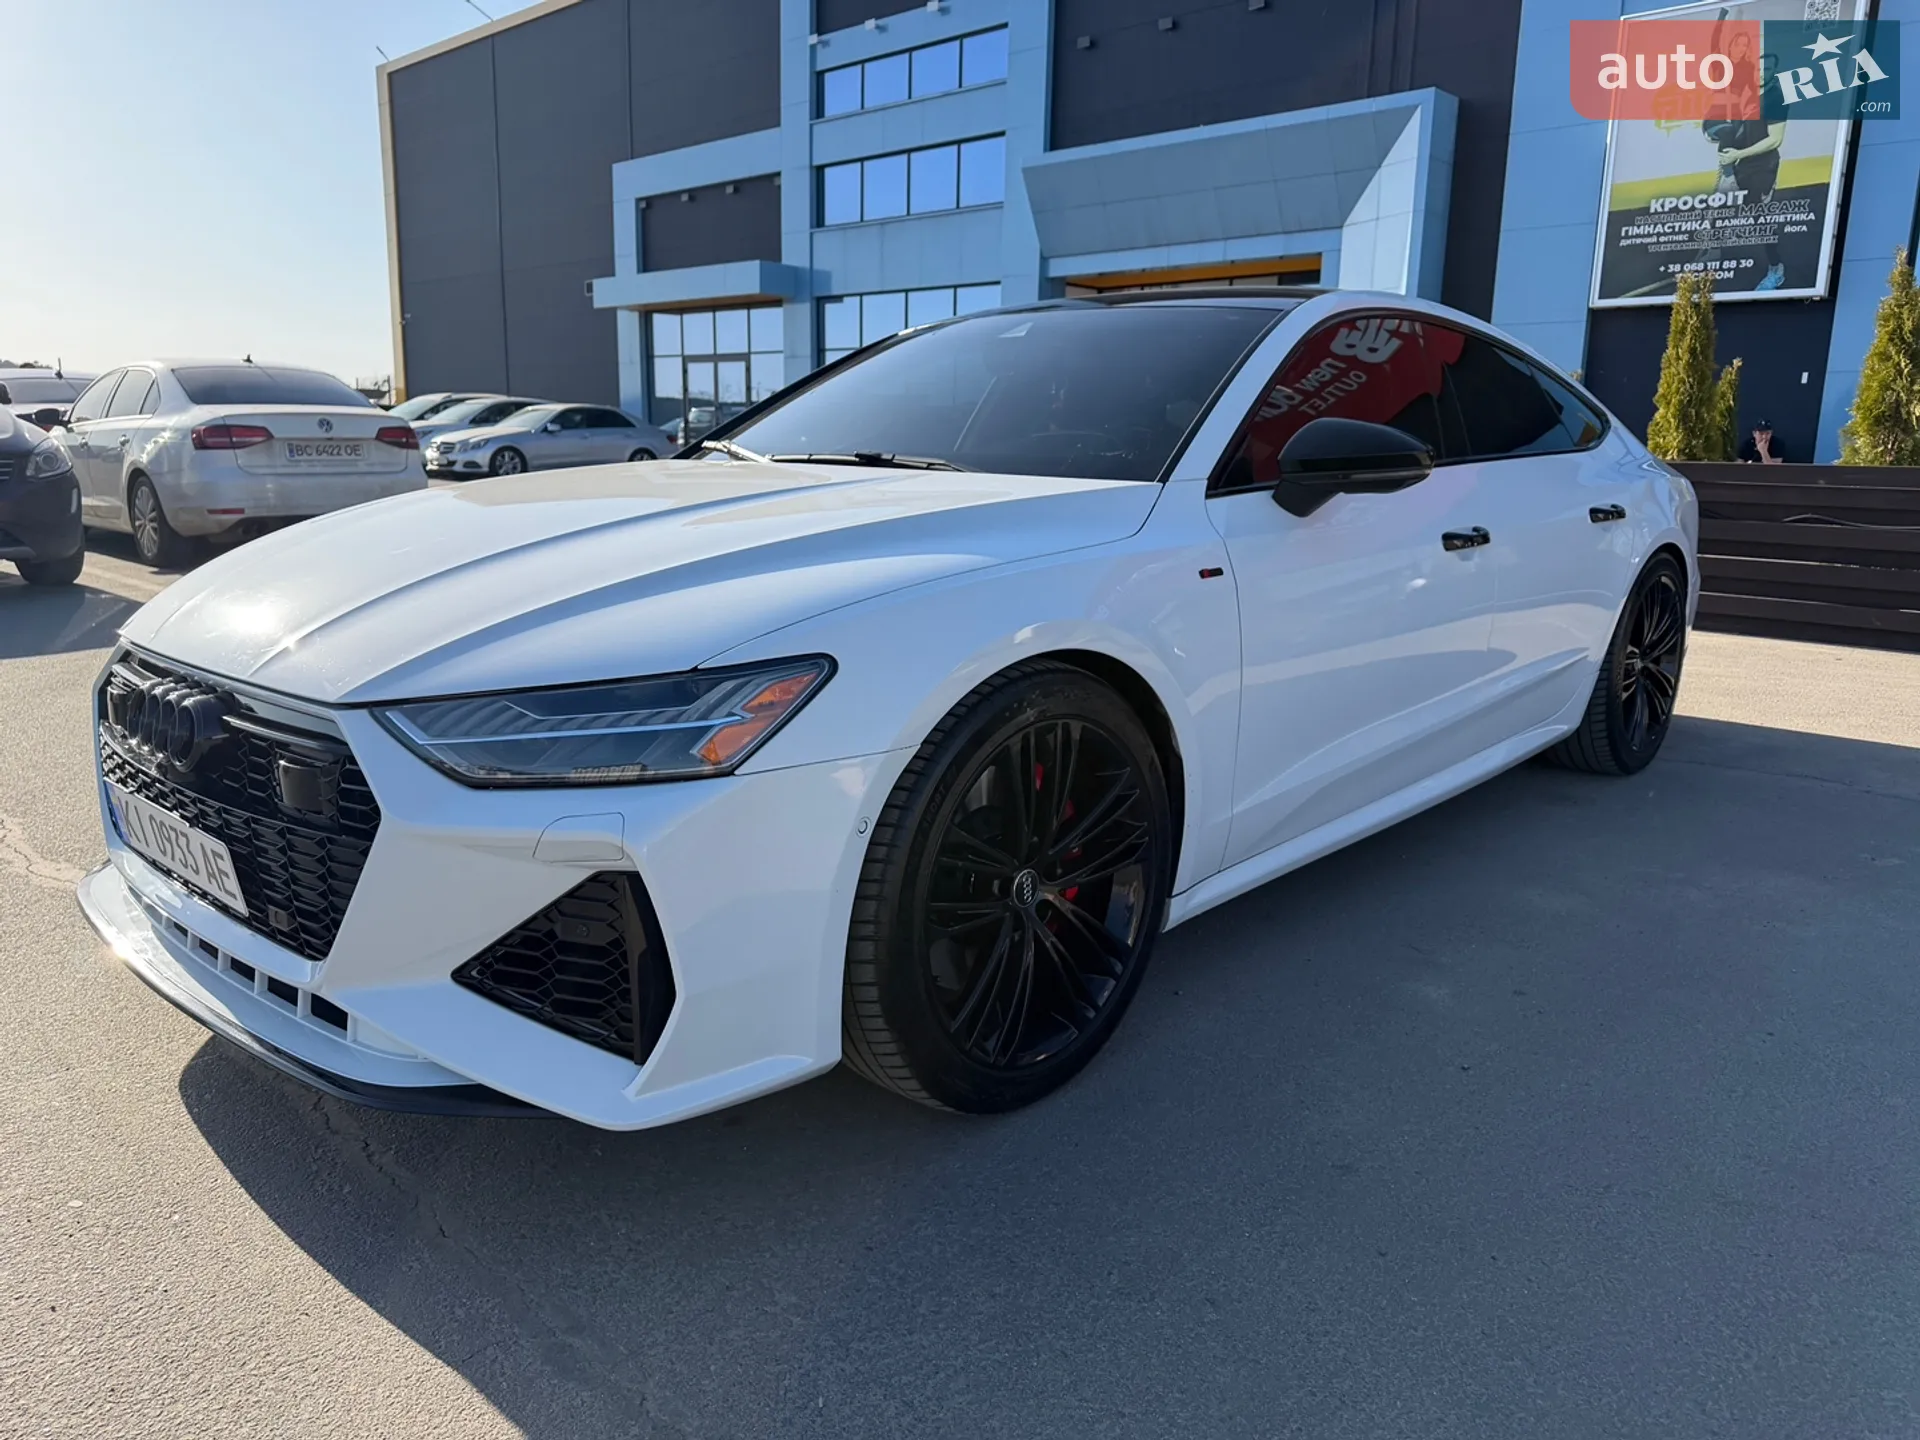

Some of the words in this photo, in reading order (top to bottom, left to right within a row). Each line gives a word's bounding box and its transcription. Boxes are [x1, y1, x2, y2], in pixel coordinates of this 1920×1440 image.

[1649, 189, 1749, 213] КРОСФІТ
[1738, 198, 1811, 217] МАСАЖ
[1620, 219, 1711, 237] ГІМНАСТИКА
[1715, 216, 1755, 228] ВАЖКА
[1757, 211, 1816, 224] АТЛЕТИКА
[1693, 224, 1778, 241] СТРЕТЧИНГ
[1784, 224, 1808, 233] ЙОГА
[1667, 264, 1681, 273] 38
[1683, 262, 1705, 271] 068
[1706, 261, 1720, 270] 111
[1722, 259, 1737, 269] 88
[1738, 258, 1754, 268] 30
[295, 444, 314, 456] BC
[315, 444, 343, 456] 6422
[344, 444, 362, 456] OE
[117, 796, 150, 848] KI
[148, 813, 200, 876] 0933
[199, 842, 238, 901] AE
